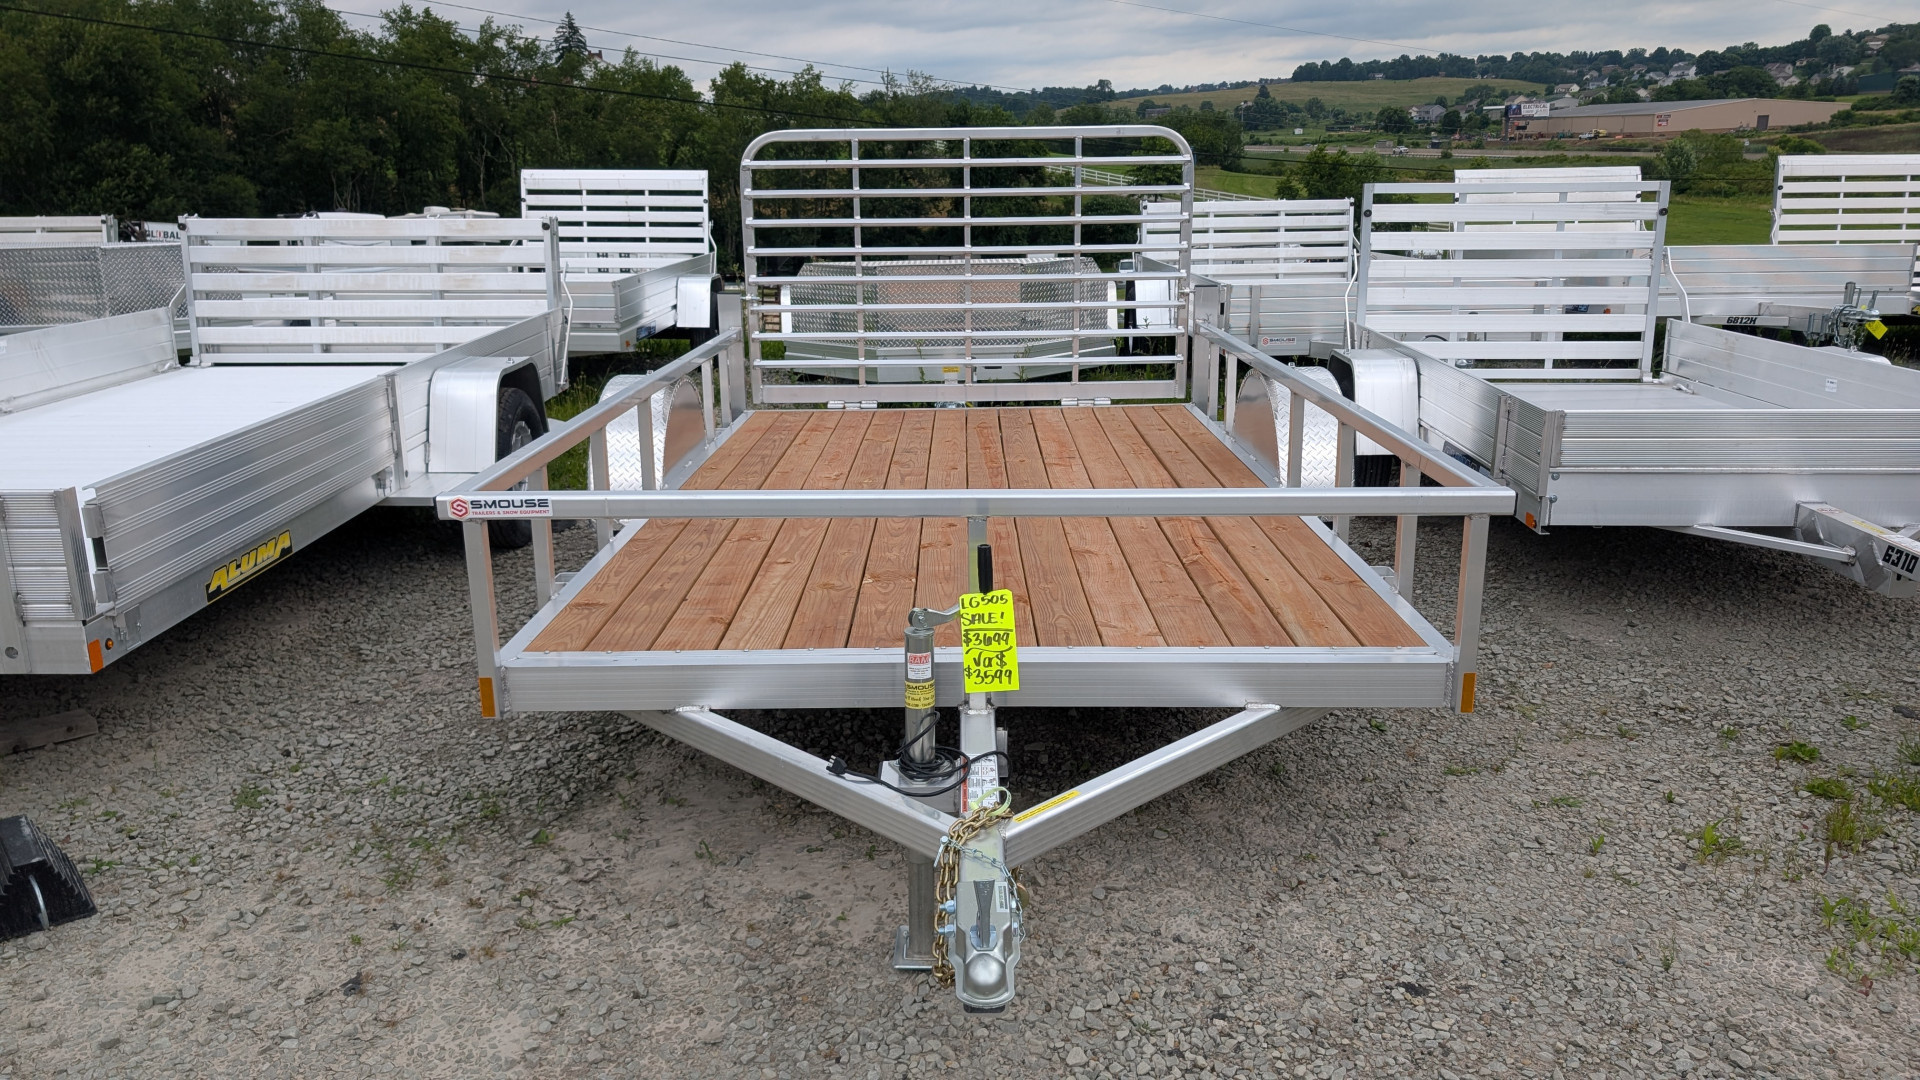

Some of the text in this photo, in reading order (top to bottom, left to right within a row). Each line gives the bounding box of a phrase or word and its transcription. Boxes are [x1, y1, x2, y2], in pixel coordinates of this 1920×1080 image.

[1726, 316, 1758, 325] 6812H
[470, 498, 550, 509] SMOUSE
[207, 530, 291, 594] ALUMA
[1881, 544, 1920, 575] 6310
[964, 664, 1013, 685] $3599
